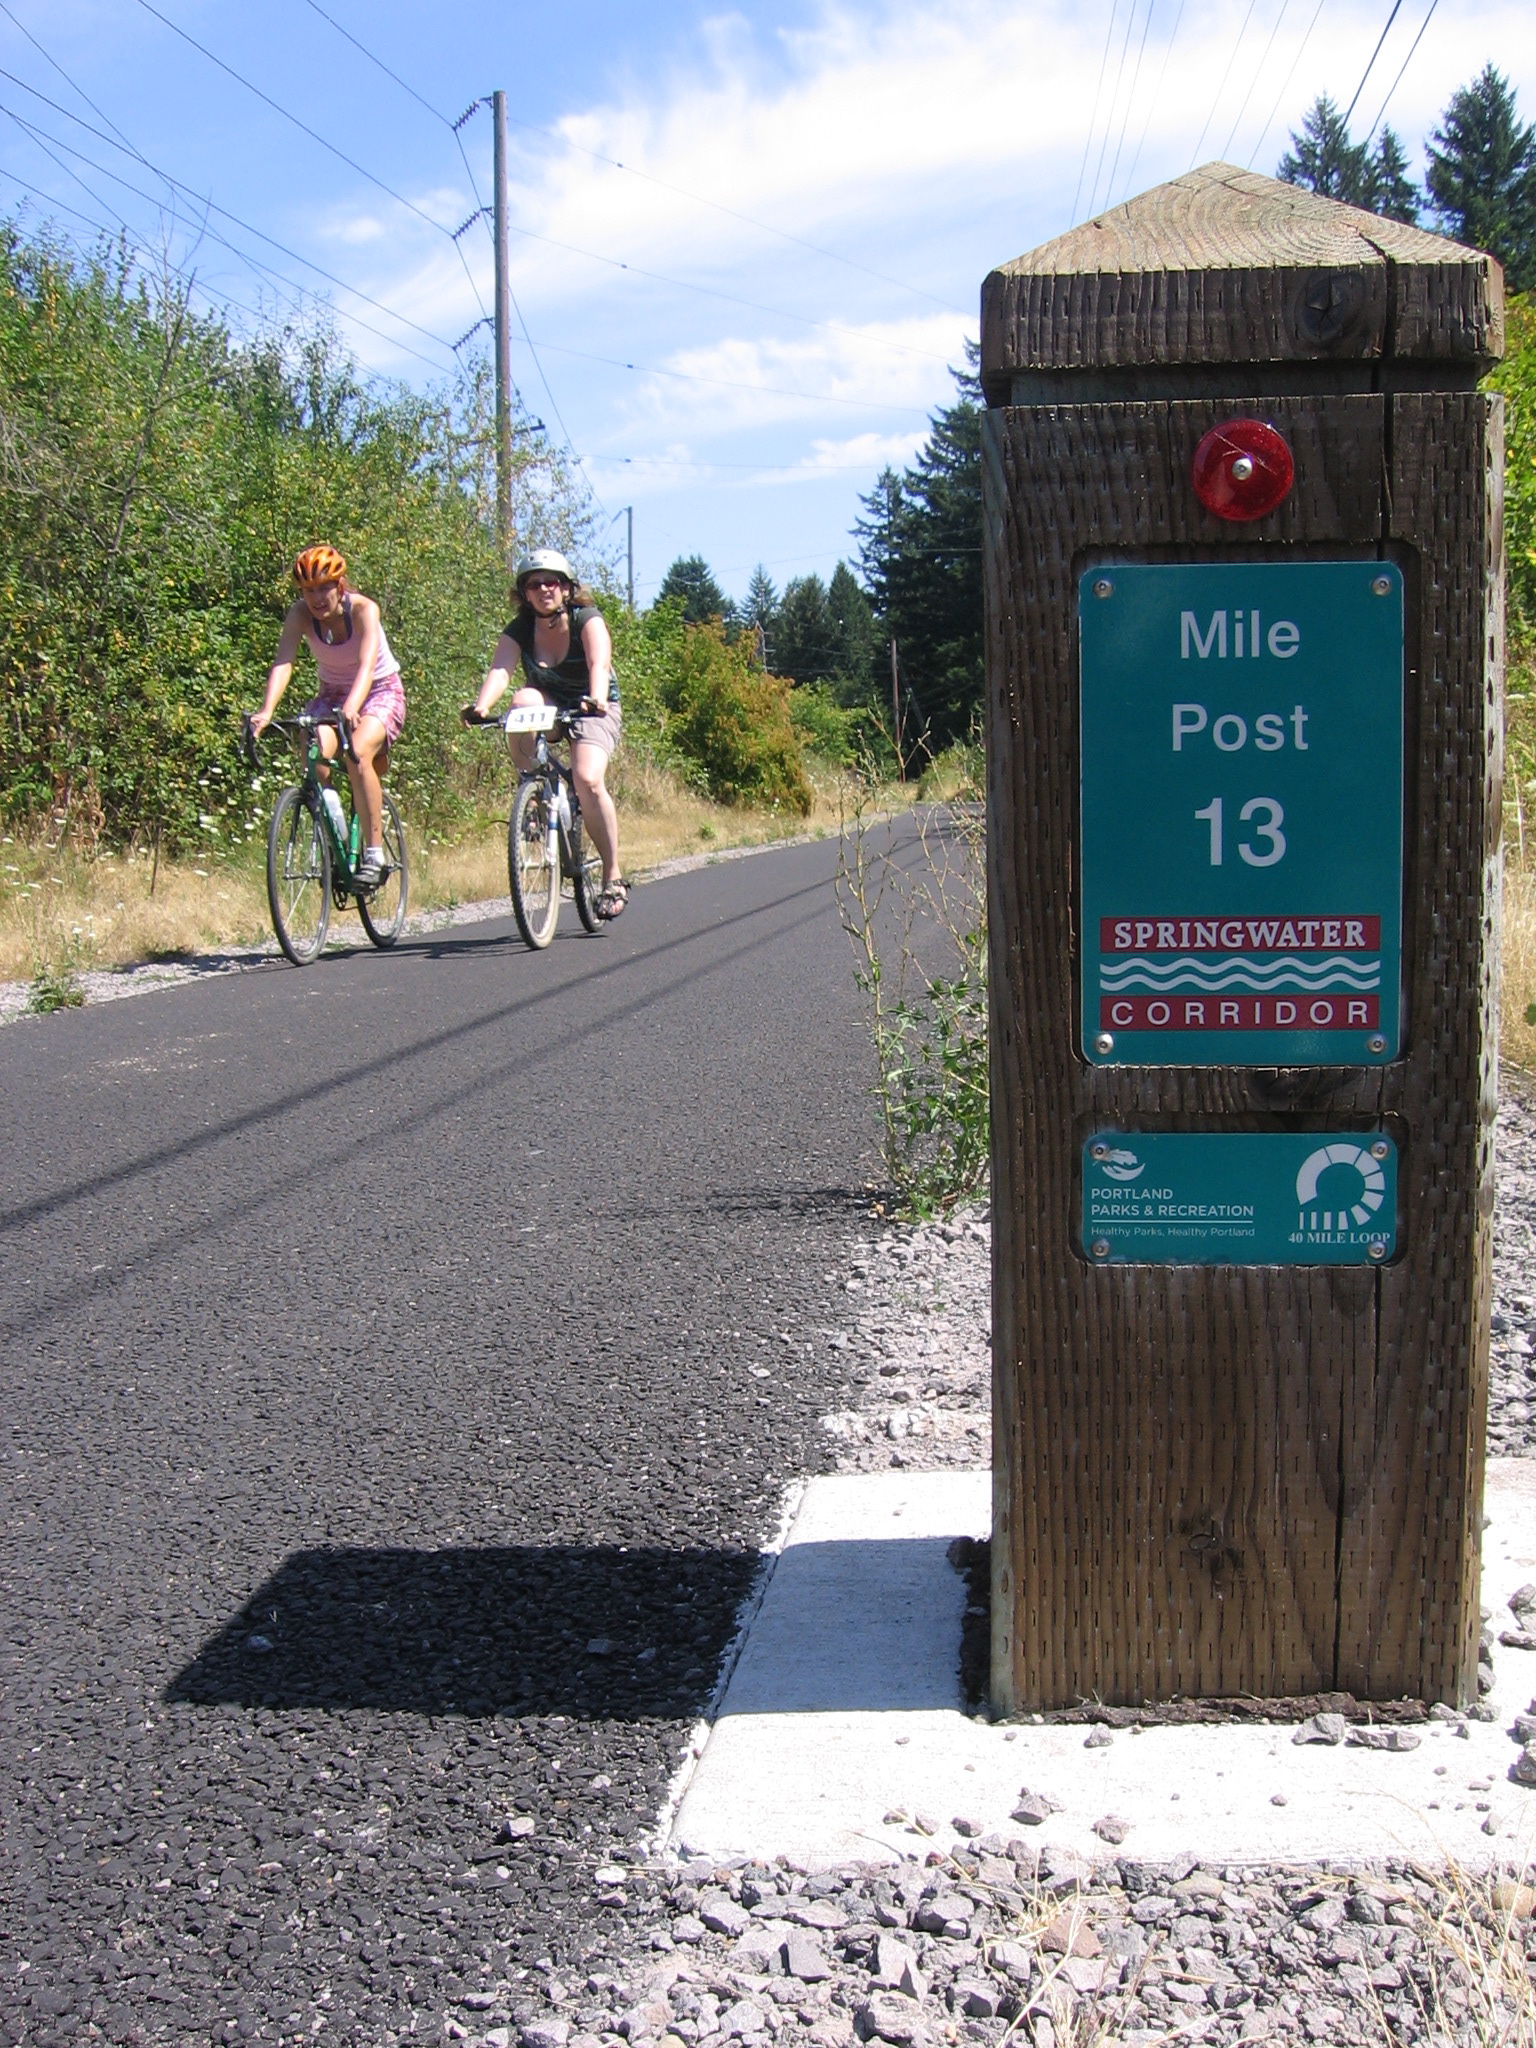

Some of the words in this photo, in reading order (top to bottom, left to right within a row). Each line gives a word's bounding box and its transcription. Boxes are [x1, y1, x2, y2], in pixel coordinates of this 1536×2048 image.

[1180, 609, 1301, 659] Mile
[514, 712, 546, 723] 411
[1171, 703, 1309, 752] Post
[1194, 797, 1287, 867] 13
[1114, 920, 1366, 949] SPRINGWATER
[1111, 1001, 1368, 1026] CORRIDOR
[1091, 1188, 1174, 1200] PORTLAND
[1091, 1204, 1140, 1216] PARKS
[1143, 1204, 1153, 1216] &
[1158, 1205, 1254, 1217] RECREATION
[1091, 1226, 1131, 1237] Healthy
[1134, 1226, 1165, 1237] Parks,
[1167, 1227, 1207, 1238] Healthy
[1210, 1227, 1255, 1237] Portland
[1288, 1232, 1303, 1244] 40
[1306, 1232, 1346, 1244] MILE
[1350, 1232, 1391, 1244] LOOP
